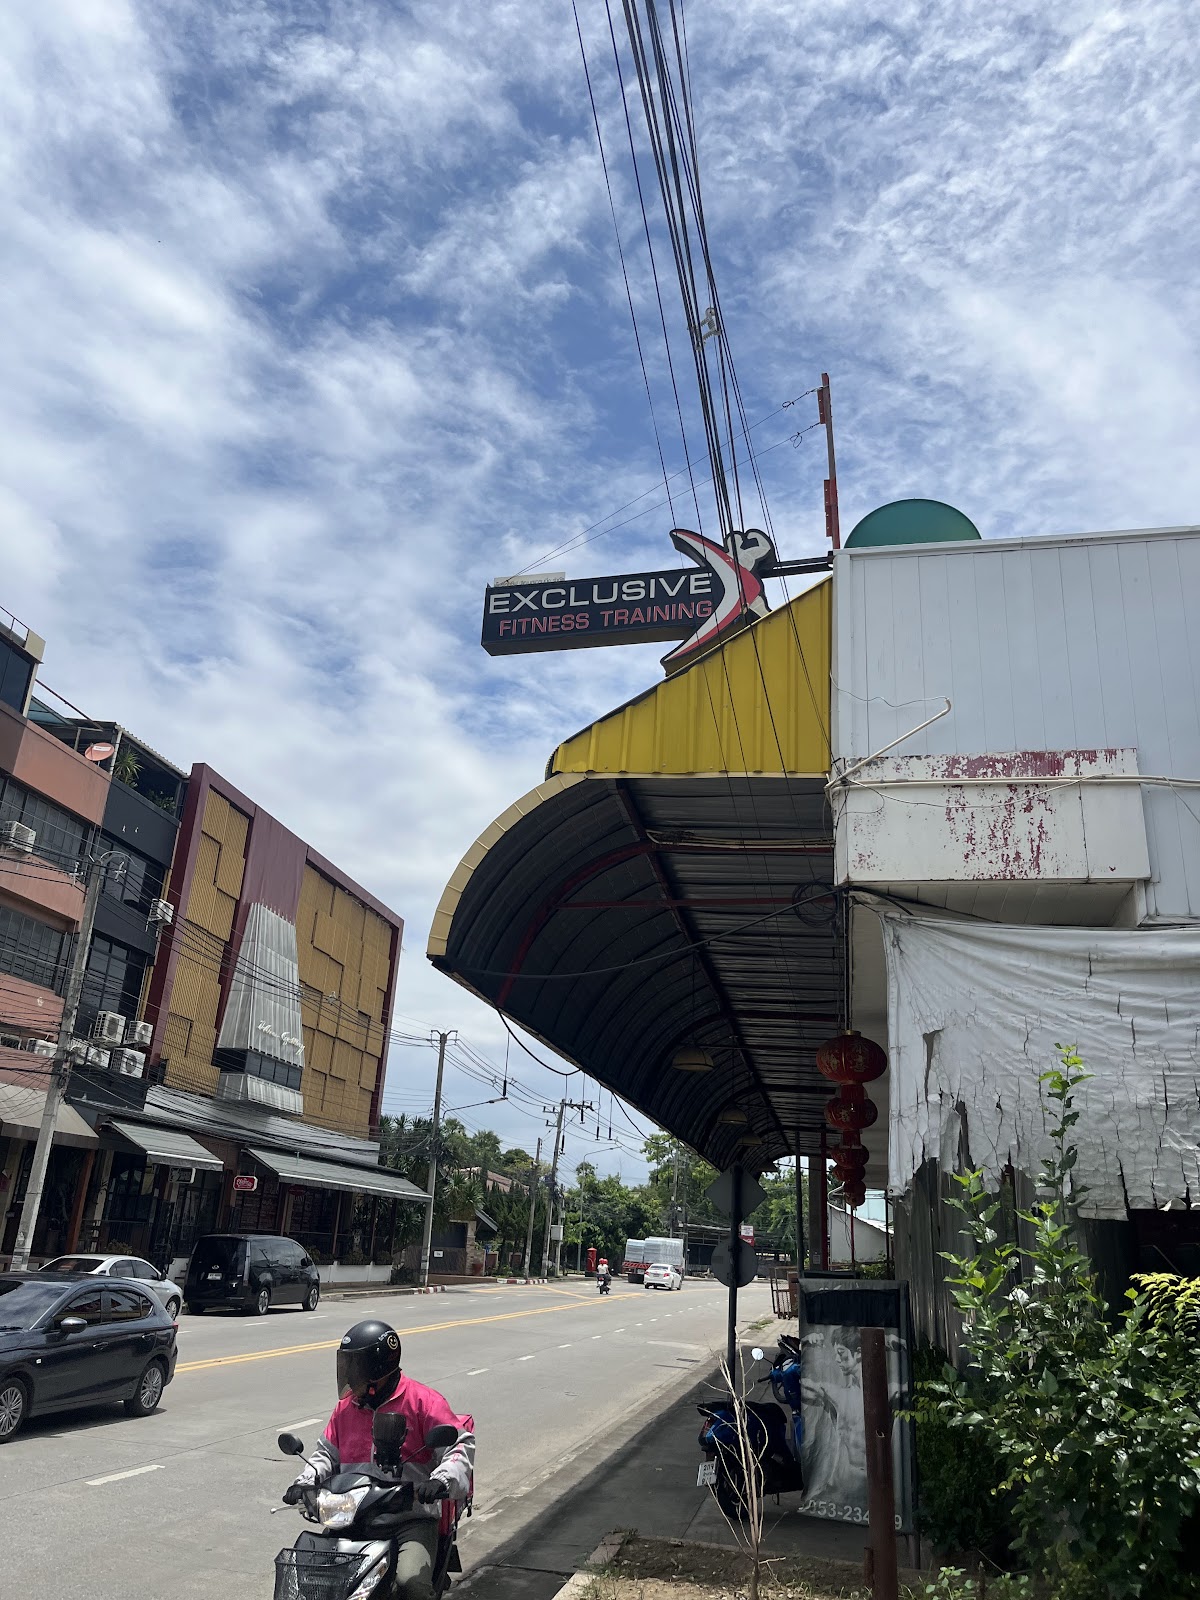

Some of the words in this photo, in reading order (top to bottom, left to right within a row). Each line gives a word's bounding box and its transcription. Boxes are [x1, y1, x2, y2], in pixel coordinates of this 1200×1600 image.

[489, 573, 712, 614] EXCLUSIVE
[500, 612, 590, 637] FITNESS
[600, 600, 713, 627] TRAINING
